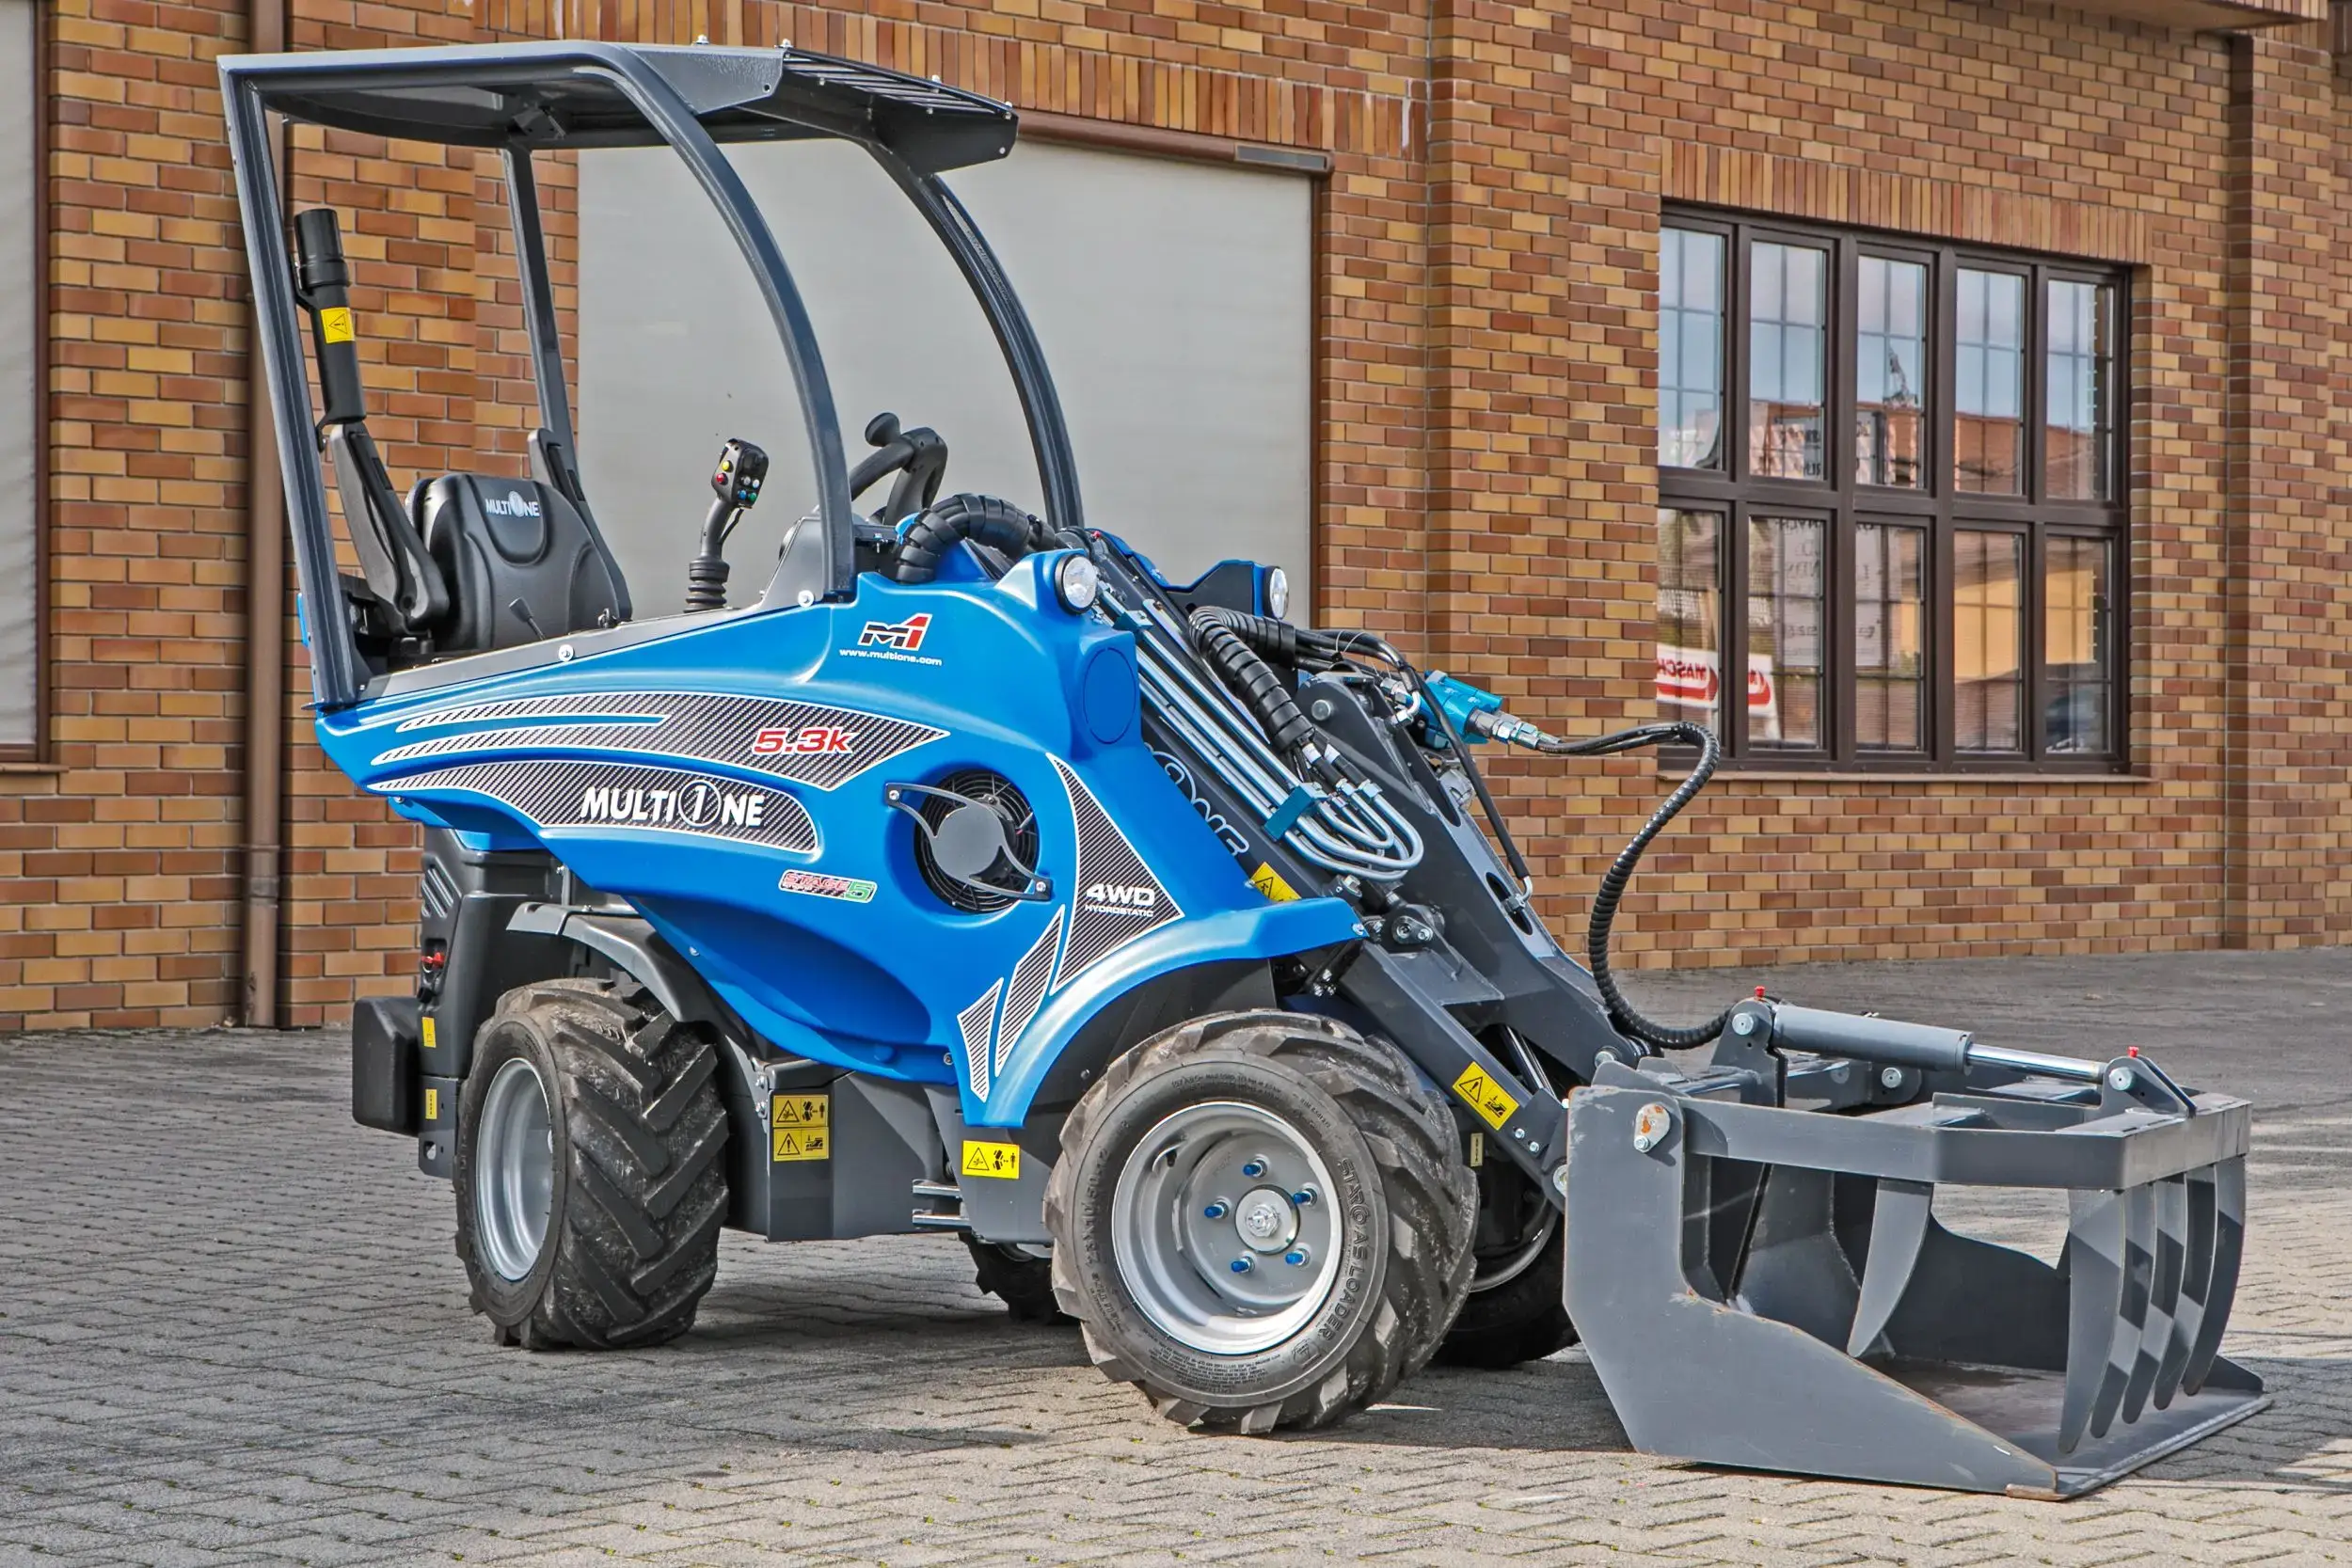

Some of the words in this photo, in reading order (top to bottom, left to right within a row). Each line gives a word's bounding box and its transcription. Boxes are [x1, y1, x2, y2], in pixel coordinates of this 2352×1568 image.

[839, 647, 943, 666] www.multione.com
[752, 727, 855, 755] 5.3k
[784, 873, 850, 891] STAGE
[846, 881, 875, 900] 5
[1086, 883, 1154, 907] 4WD
[1085, 904, 1154, 918] HYDROSTATIC
[1318, 1262, 1364, 1341] LOADER
